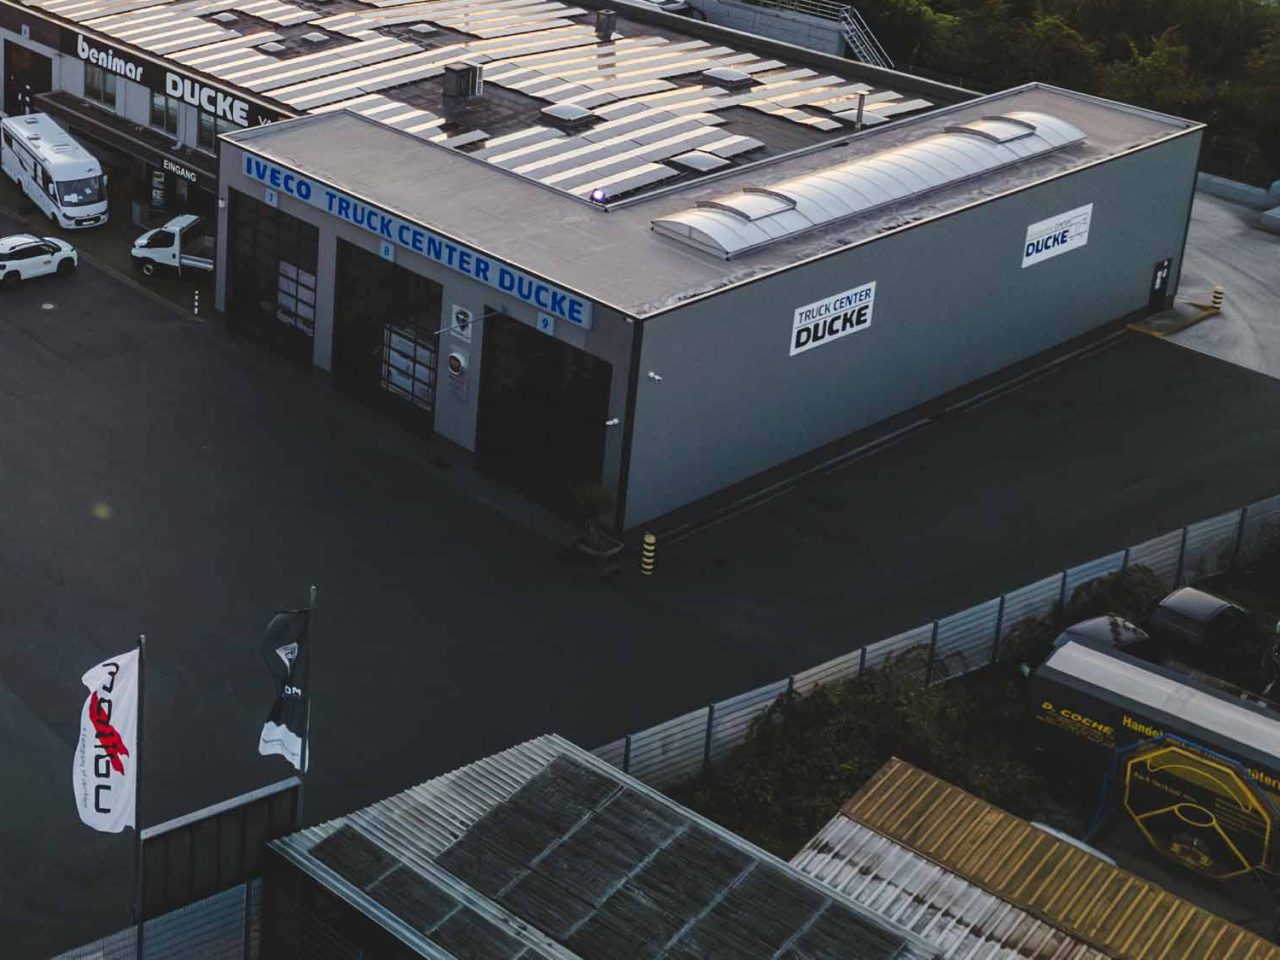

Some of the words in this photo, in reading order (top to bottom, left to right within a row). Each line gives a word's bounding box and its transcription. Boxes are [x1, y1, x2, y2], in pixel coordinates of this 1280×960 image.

[77, 34, 144, 82] benimar
[165, 72, 249, 127] DUCKE
[163, 159, 197, 182] EINGANG
[246, 156, 311, 200] IVECO
[326, 191, 393, 239] TRUCK
[398, 224, 490, 282] CENTER
[499, 268, 584, 324] DUCKE
[1025, 229, 1069, 257] DUCKE
[794, 304, 870, 349] DUCKE
[798, 301, 831, 323] TRUCK
[834, 288, 872, 313] CENTER
